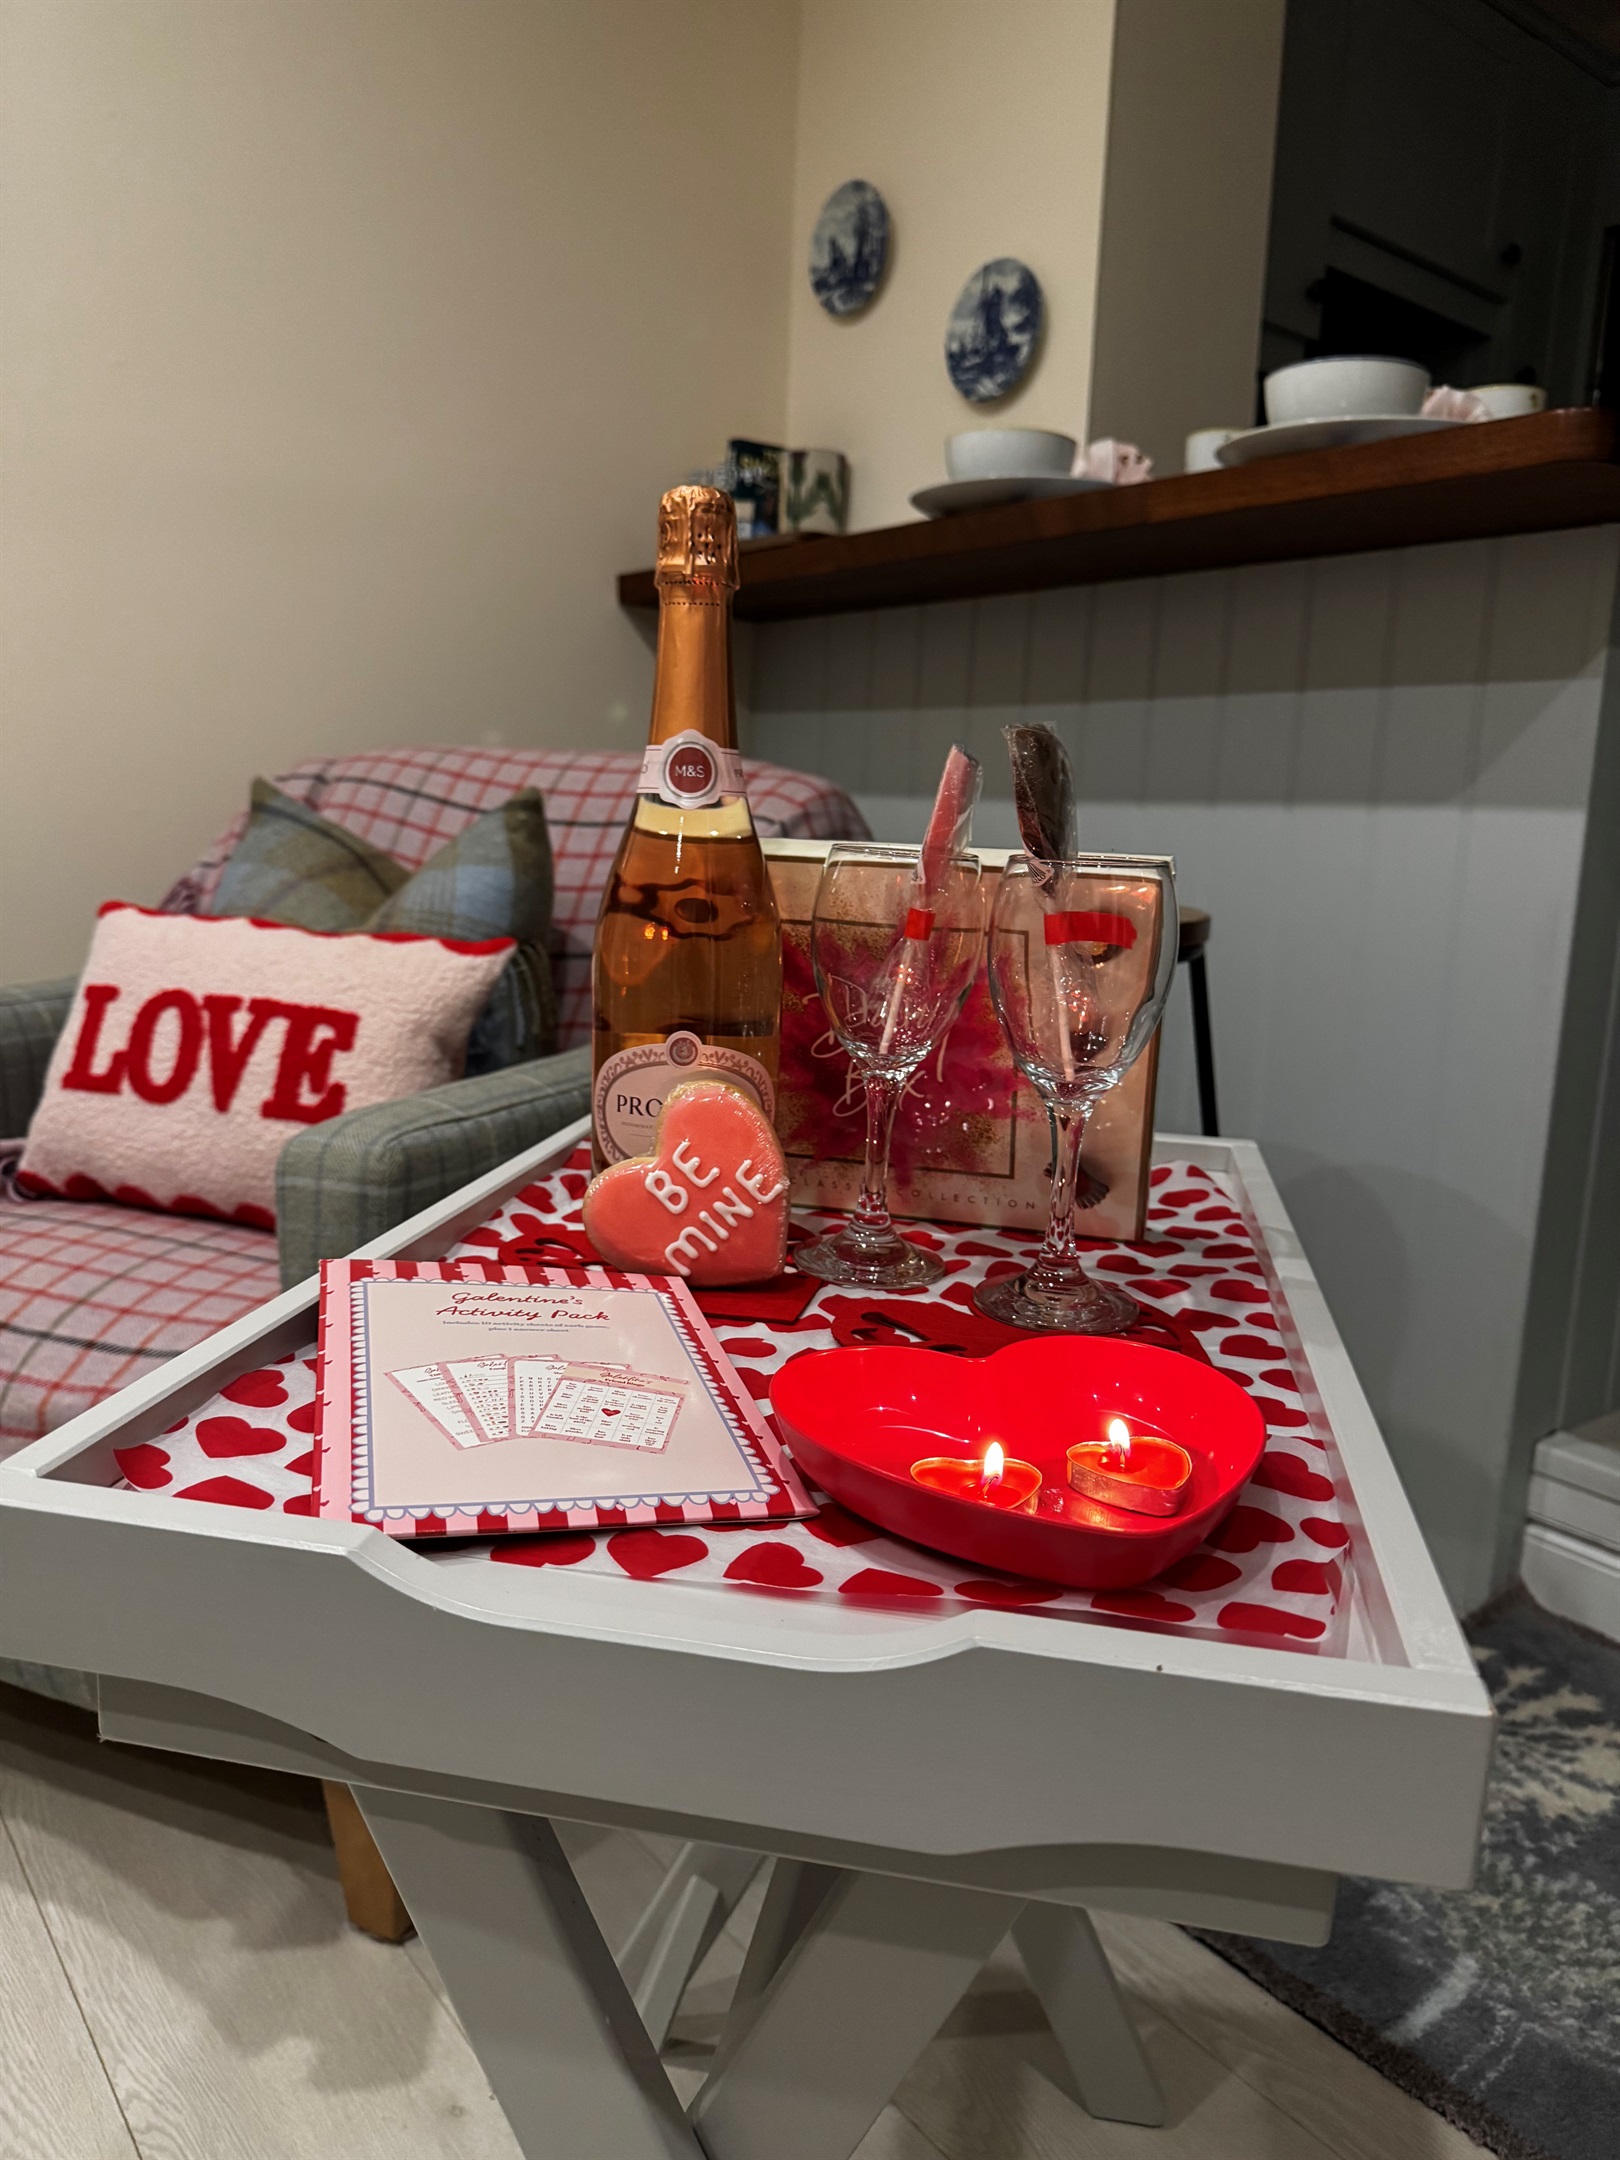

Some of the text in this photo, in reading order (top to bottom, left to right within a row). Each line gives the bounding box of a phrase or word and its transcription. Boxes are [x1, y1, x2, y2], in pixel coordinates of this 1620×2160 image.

[674, 765, 706, 778] M&S
[62, 984, 360, 1125] LOVE
[832, 1056, 926, 1118] Bx
[645, 1138, 721, 1215] BE
[664, 1159, 785, 1277] MINE
[896, 1187, 1036, 1210] COLLECTION
[435, 1305, 611, 1321] Activity Pack
[451, 1291, 584, 1305] Galentine's
